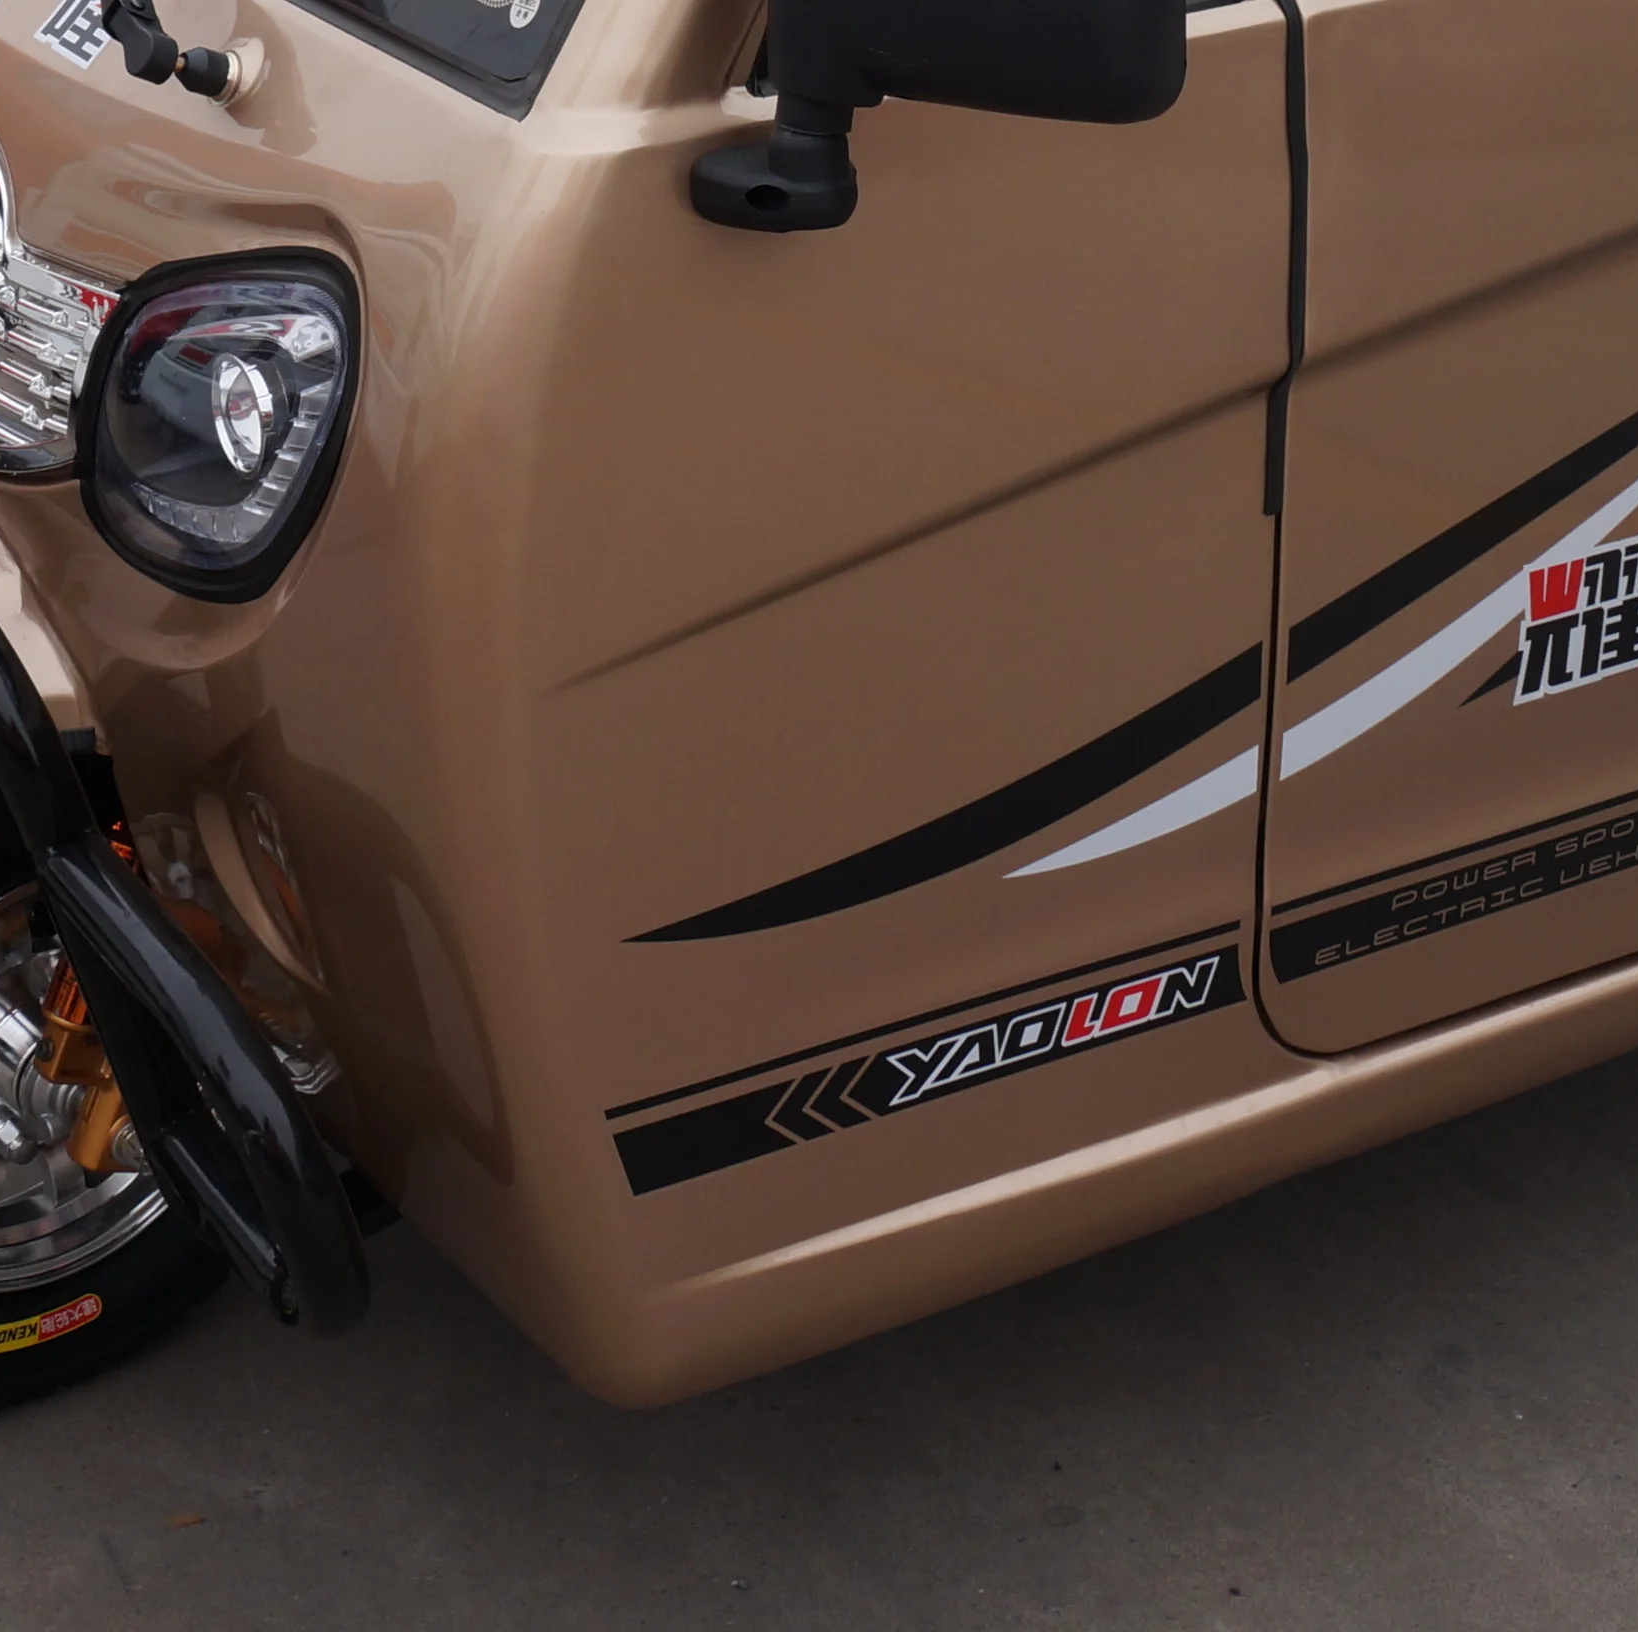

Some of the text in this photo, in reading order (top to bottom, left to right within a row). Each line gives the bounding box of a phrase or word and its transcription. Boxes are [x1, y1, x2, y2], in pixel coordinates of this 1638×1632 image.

[1313, 875, 1545, 966] ELECTRIC
[1390, 849, 1537, 912] POWER
[886, 955, 1220, 1107] YAOLON
